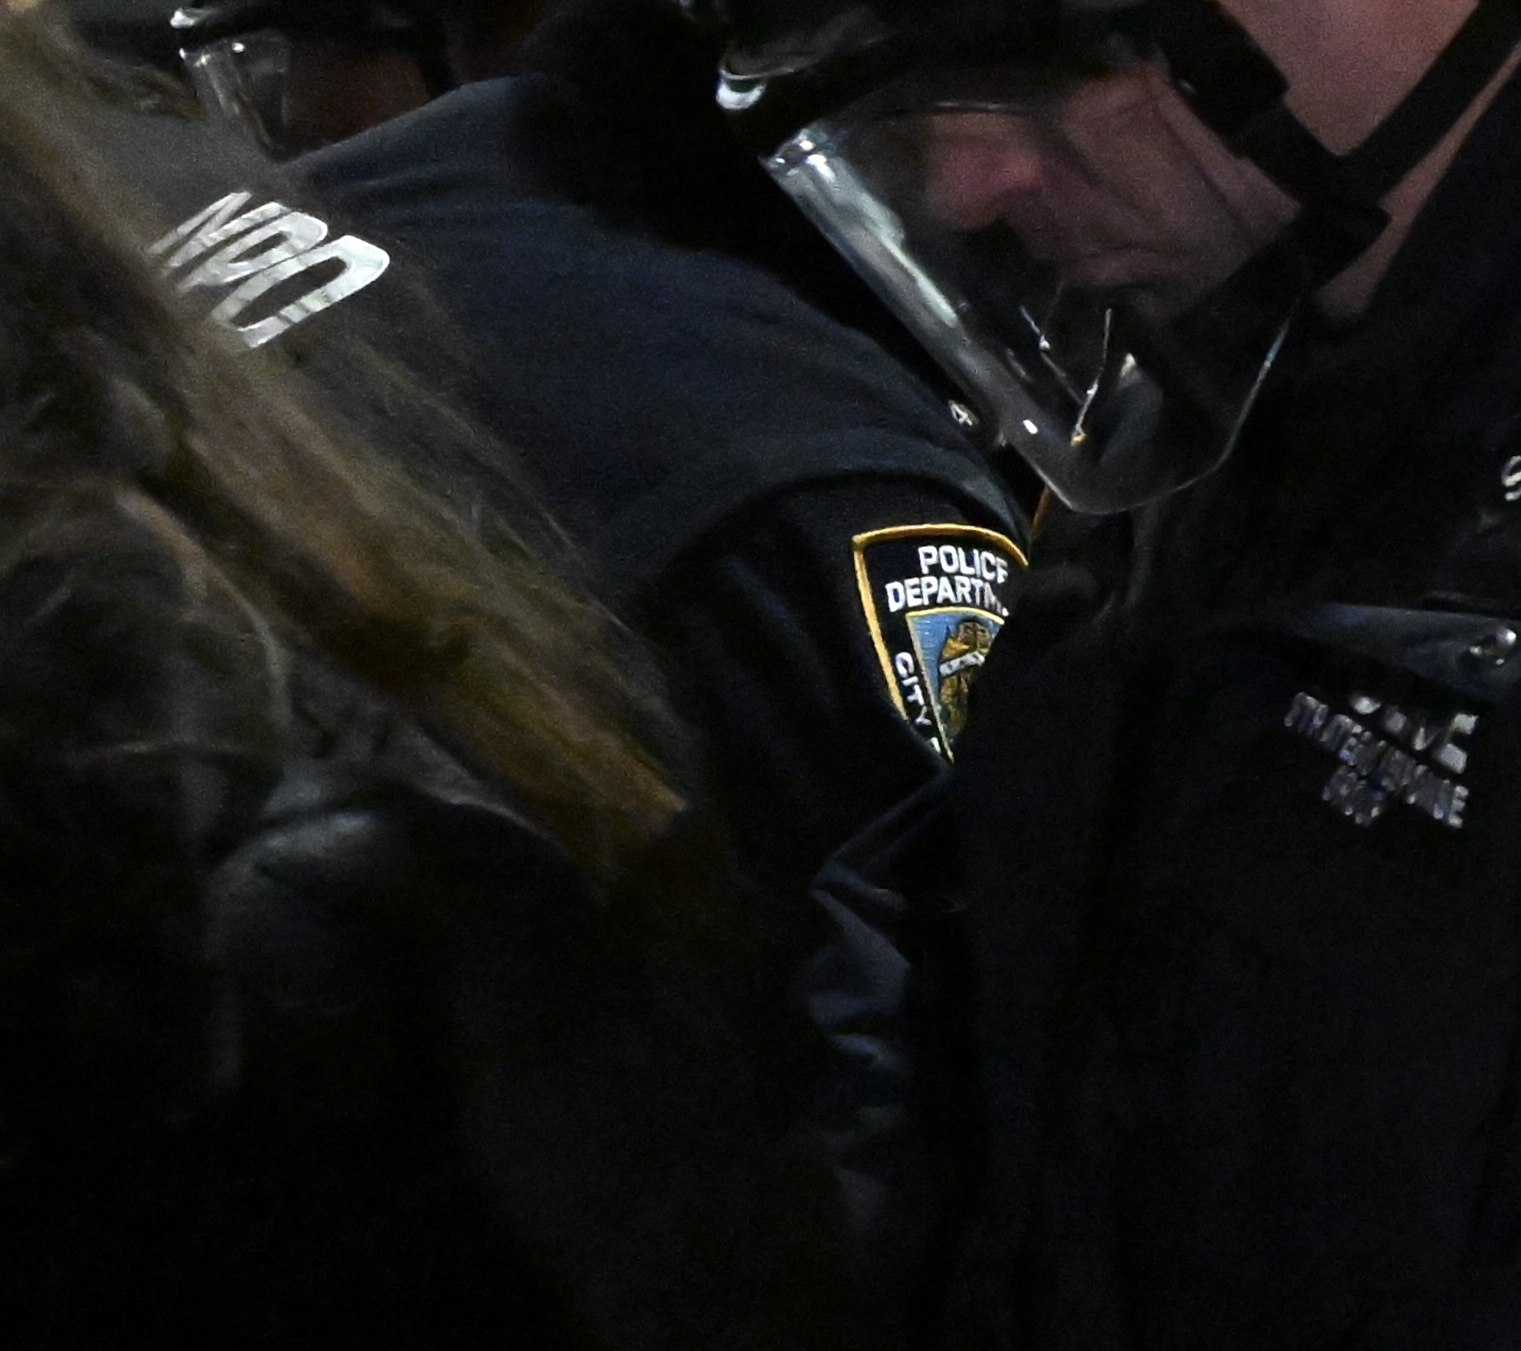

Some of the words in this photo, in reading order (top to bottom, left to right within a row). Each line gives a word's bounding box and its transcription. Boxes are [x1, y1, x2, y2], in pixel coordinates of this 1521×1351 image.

[147, 190, 390, 349] YPD
[917, 544, 1009, 585] POLICE
[884, 574, 1010, 618] DEPARTM
[894, 651, 932, 726] CITY
